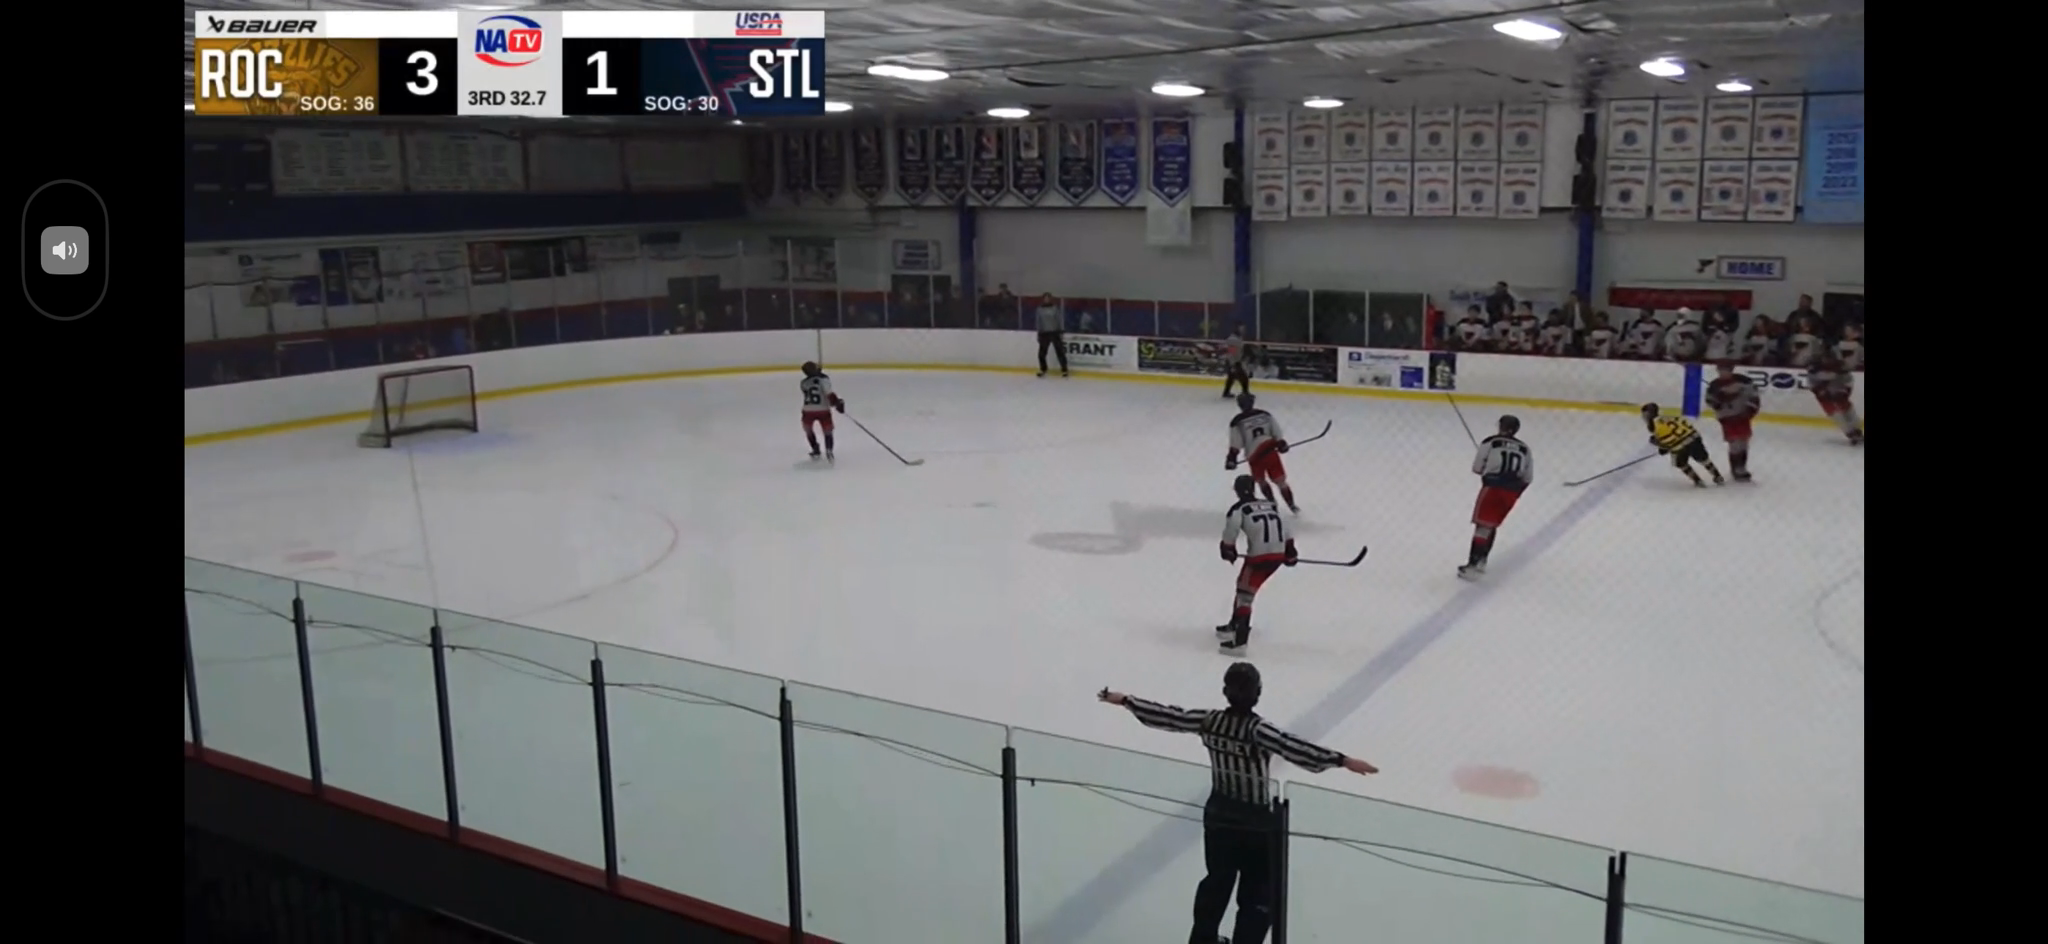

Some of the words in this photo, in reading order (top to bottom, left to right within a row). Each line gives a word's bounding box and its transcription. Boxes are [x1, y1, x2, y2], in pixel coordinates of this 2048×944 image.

[1727, 262, 1774, 275] HOME
[1501, 450, 1522, 474] 10
[1251, 513, 1283, 543] 77
